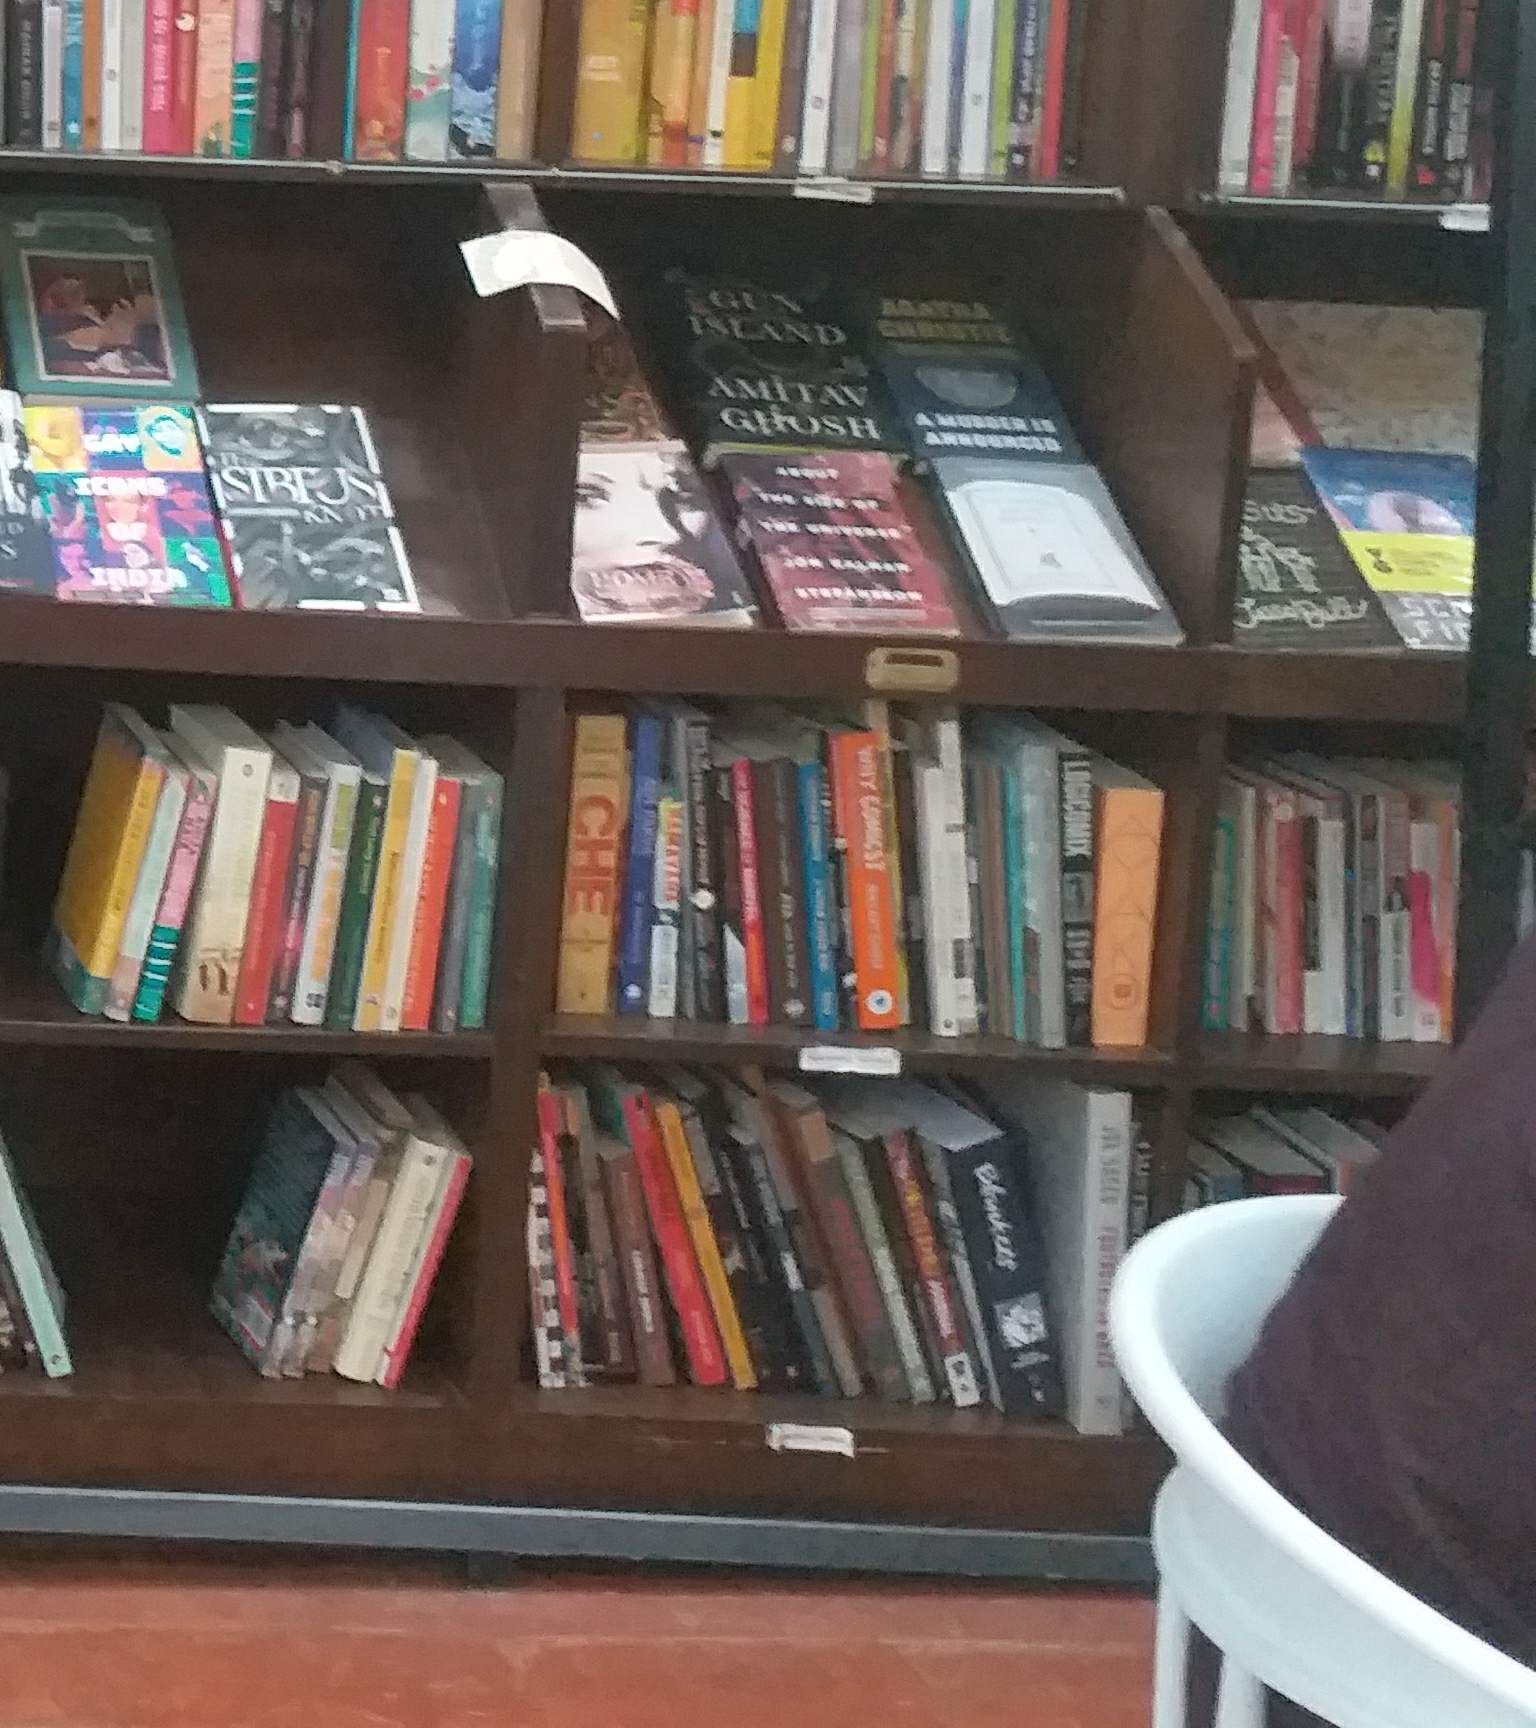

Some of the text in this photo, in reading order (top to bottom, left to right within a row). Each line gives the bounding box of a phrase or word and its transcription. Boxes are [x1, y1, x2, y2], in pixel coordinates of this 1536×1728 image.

[688, 315, 848, 348] ISLAND
[709, 375, 869, 409] AMITAV
[718, 408, 882, 441] GHOSH
[570, 793, 618, 918] CHE
